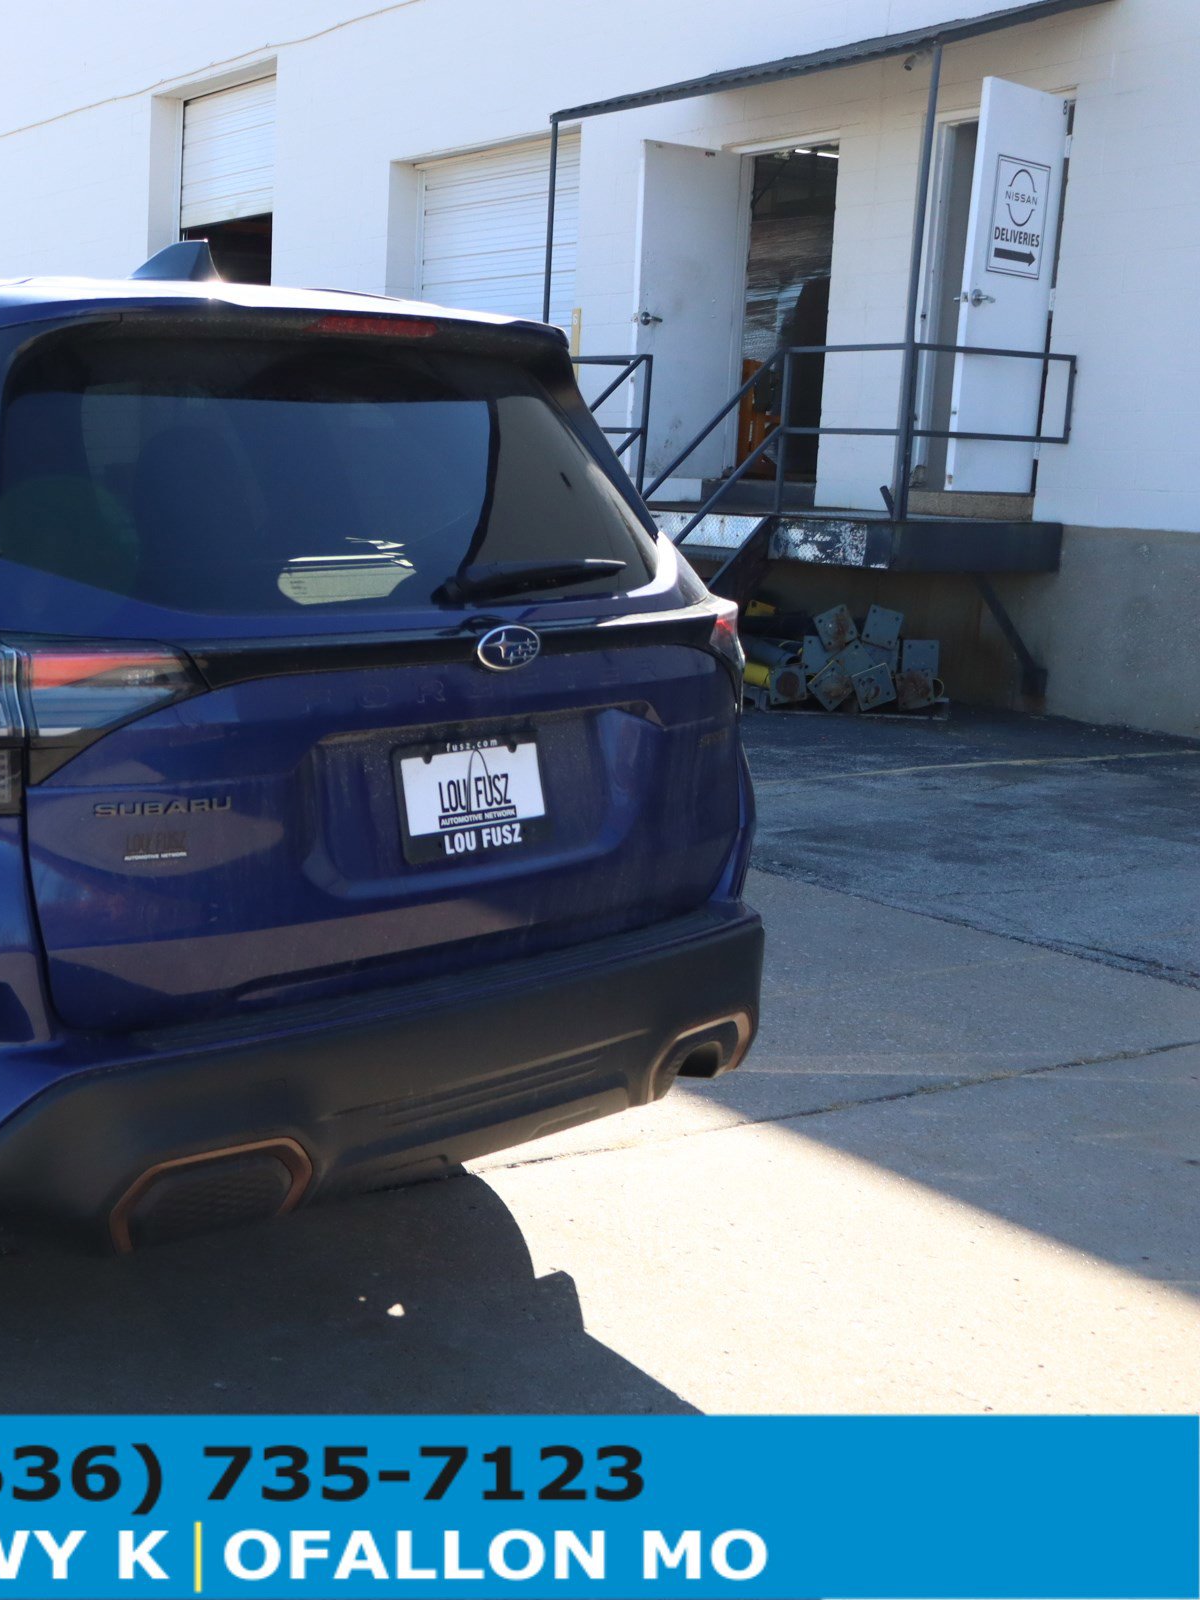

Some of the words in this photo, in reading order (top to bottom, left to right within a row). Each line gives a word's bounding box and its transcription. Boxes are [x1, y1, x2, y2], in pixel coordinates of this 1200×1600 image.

[1005, 190, 1038, 206] NISSAN
[994, 226, 1040, 247] DELIVERIES
[446, 739, 498, 752] fusz.com
[438, 777, 467, 813] LOU
[474, 773, 512, 808] FUSZ
[94, 796, 231, 817] SUBARU
[440, 814, 483, 826] AUTOMOTIVE
[485, 808, 516, 820] NETWORK
[444, 830, 477, 855] LOU
[482, 823, 522, 848] FUSZ
